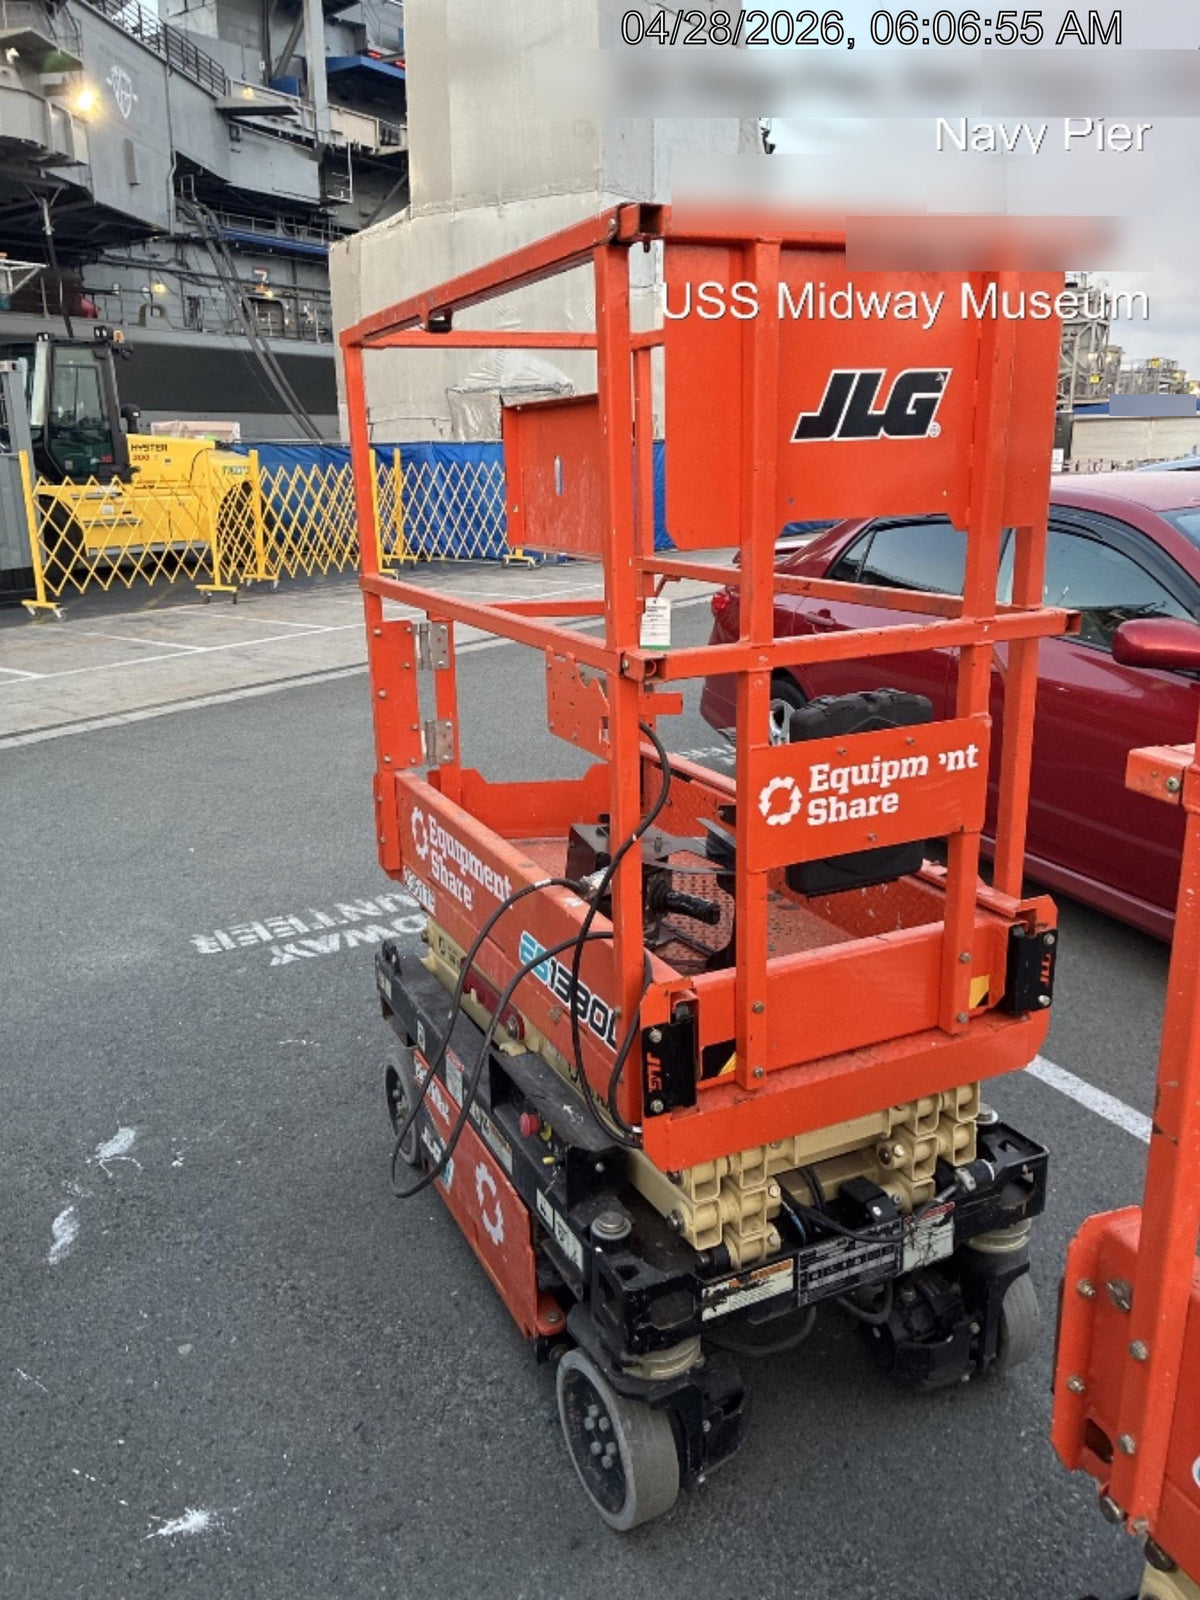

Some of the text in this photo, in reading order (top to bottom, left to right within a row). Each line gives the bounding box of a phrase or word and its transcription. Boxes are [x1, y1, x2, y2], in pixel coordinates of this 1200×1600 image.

[790, 368, 953, 443] JLG
[131, 443, 168, 452] HYSTER
[806, 792, 899, 826] Share
[427, 813, 513, 910] Equipment
[430, 847, 474, 912] Share
[646, 1051, 663, 1092] JLG
